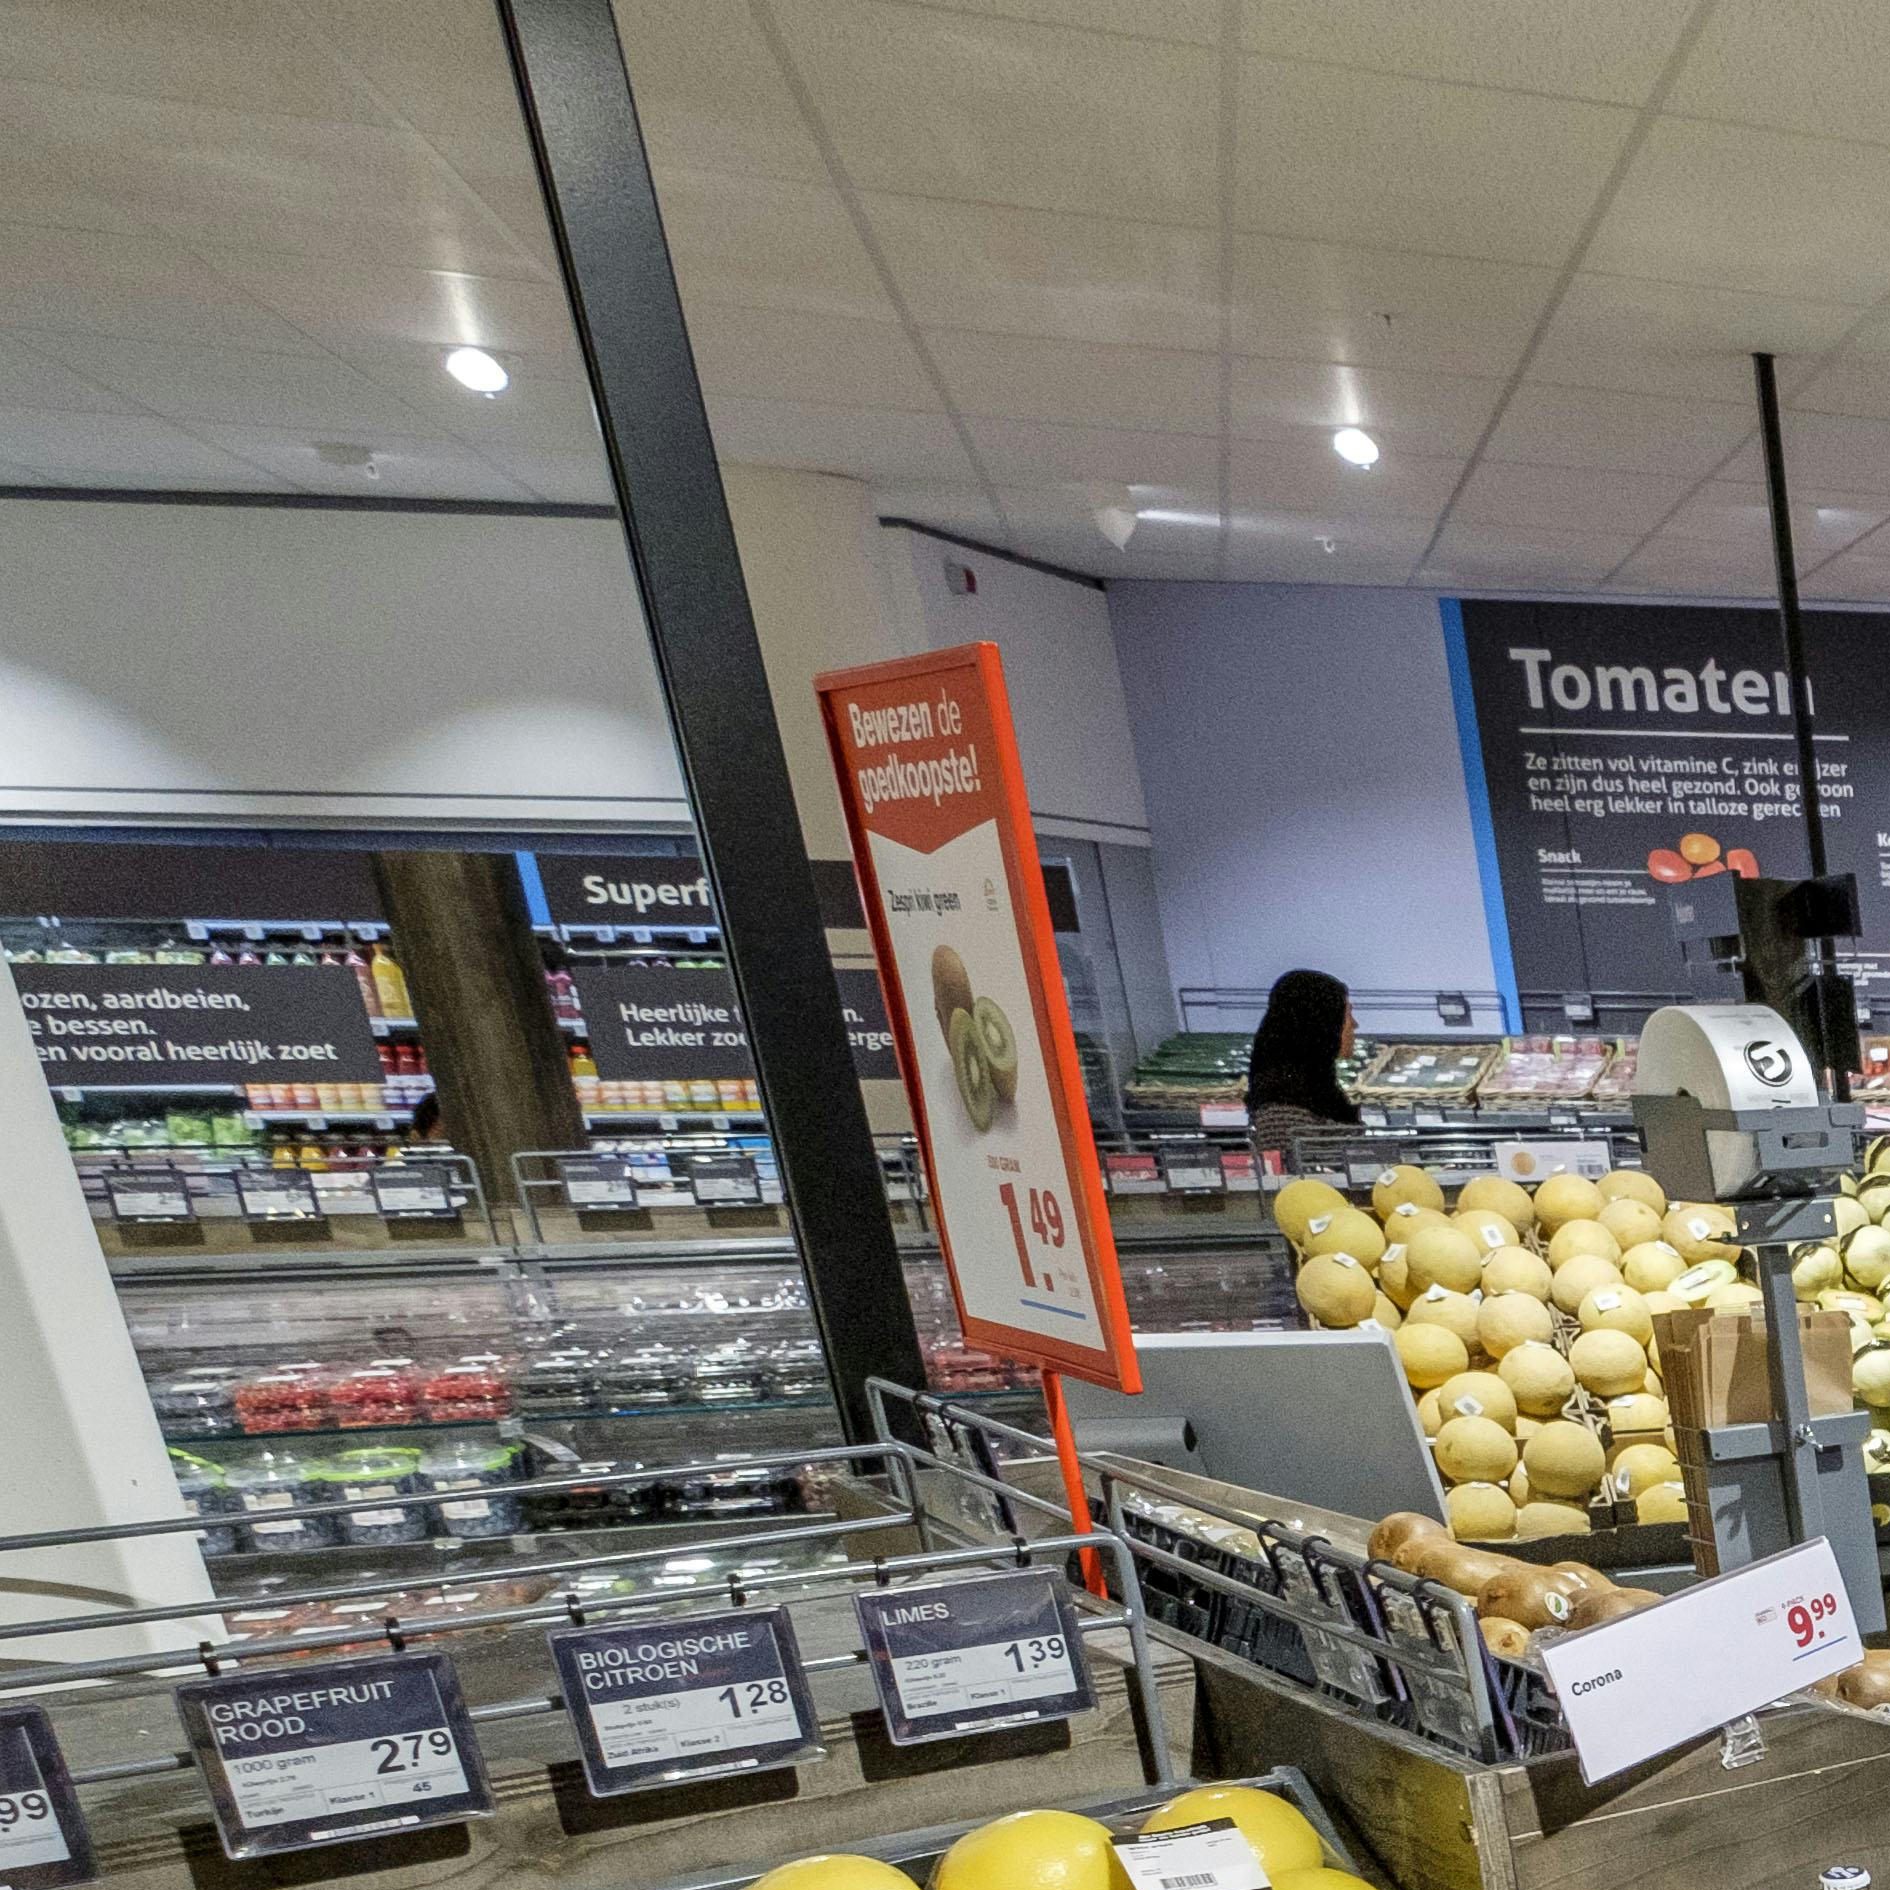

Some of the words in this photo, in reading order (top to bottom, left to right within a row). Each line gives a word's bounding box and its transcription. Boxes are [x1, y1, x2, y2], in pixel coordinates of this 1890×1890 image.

[848, 701, 934, 749] Bewezen
[937, 687, 962, 737] de
[1524, 753, 1548, 771] Ze
[1552, 753, 1601, 772] zitten
[1608, 756, 1636, 773] vol
[1640, 756, 1717, 775] vitamine
[1722, 757, 1740, 777] C,
[1742, 757, 1779, 776] zink
[857, 743, 982, 815] goedkoopste!
[1528, 777, 1550, 792] en
[1556, 774, 1588, 795] zijn
[1592, 775, 1623, 792] dus
[1628, 776, 1668, 794] heel
[1671, 778, 1741, 799] gezond.
[1745, 778, 1781, 797] Ook
[1530, 795, 1571, 812] heel
[1575, 798, 1604, 817] erg
[1609, 796, 1663, 814] lekker
[1669, 797, 1686, 814] in
[1689, 798, 1749, 816] talloze
[1537, 848, 1582, 864] Snack
[583, 875, 711, 914] Superf
[102, 987, 251, 1013] aardbeien,
[49, 1015, 156, 1037] bessen.
[620, 1003, 729, 1027] Heerlijke
[626, 1028, 706, 1048] Lekker
[72, 1041, 165, 1063] vooral
[167, 1040, 276, 1065] heerlijk
[279, 1042, 340, 1062] zoet
[881, 1602, 951, 1626] LIMES
[578, 1631, 752, 1670] BIOLOGISCHE
[584, 1658, 700, 1690] CITROEN
[905, 1659, 929, 1671] 220
[931, 1655, 962, 1668] gram
[1571, 1667, 1624, 1697] Corona
[210, 1680, 395, 1724] GRAPEFRUIT
[622, 1704, 633, 1715] 2
[635, 1698, 681, 1713] stuk(s)
[679, 1736, 713, 1748] Klasse
[233, 1759, 273, 1775] 1000
[276, 1753, 317, 1771] gram
[329, 1792, 366, 1806] Klasse
[412, 1781, 433, 1793] 45
